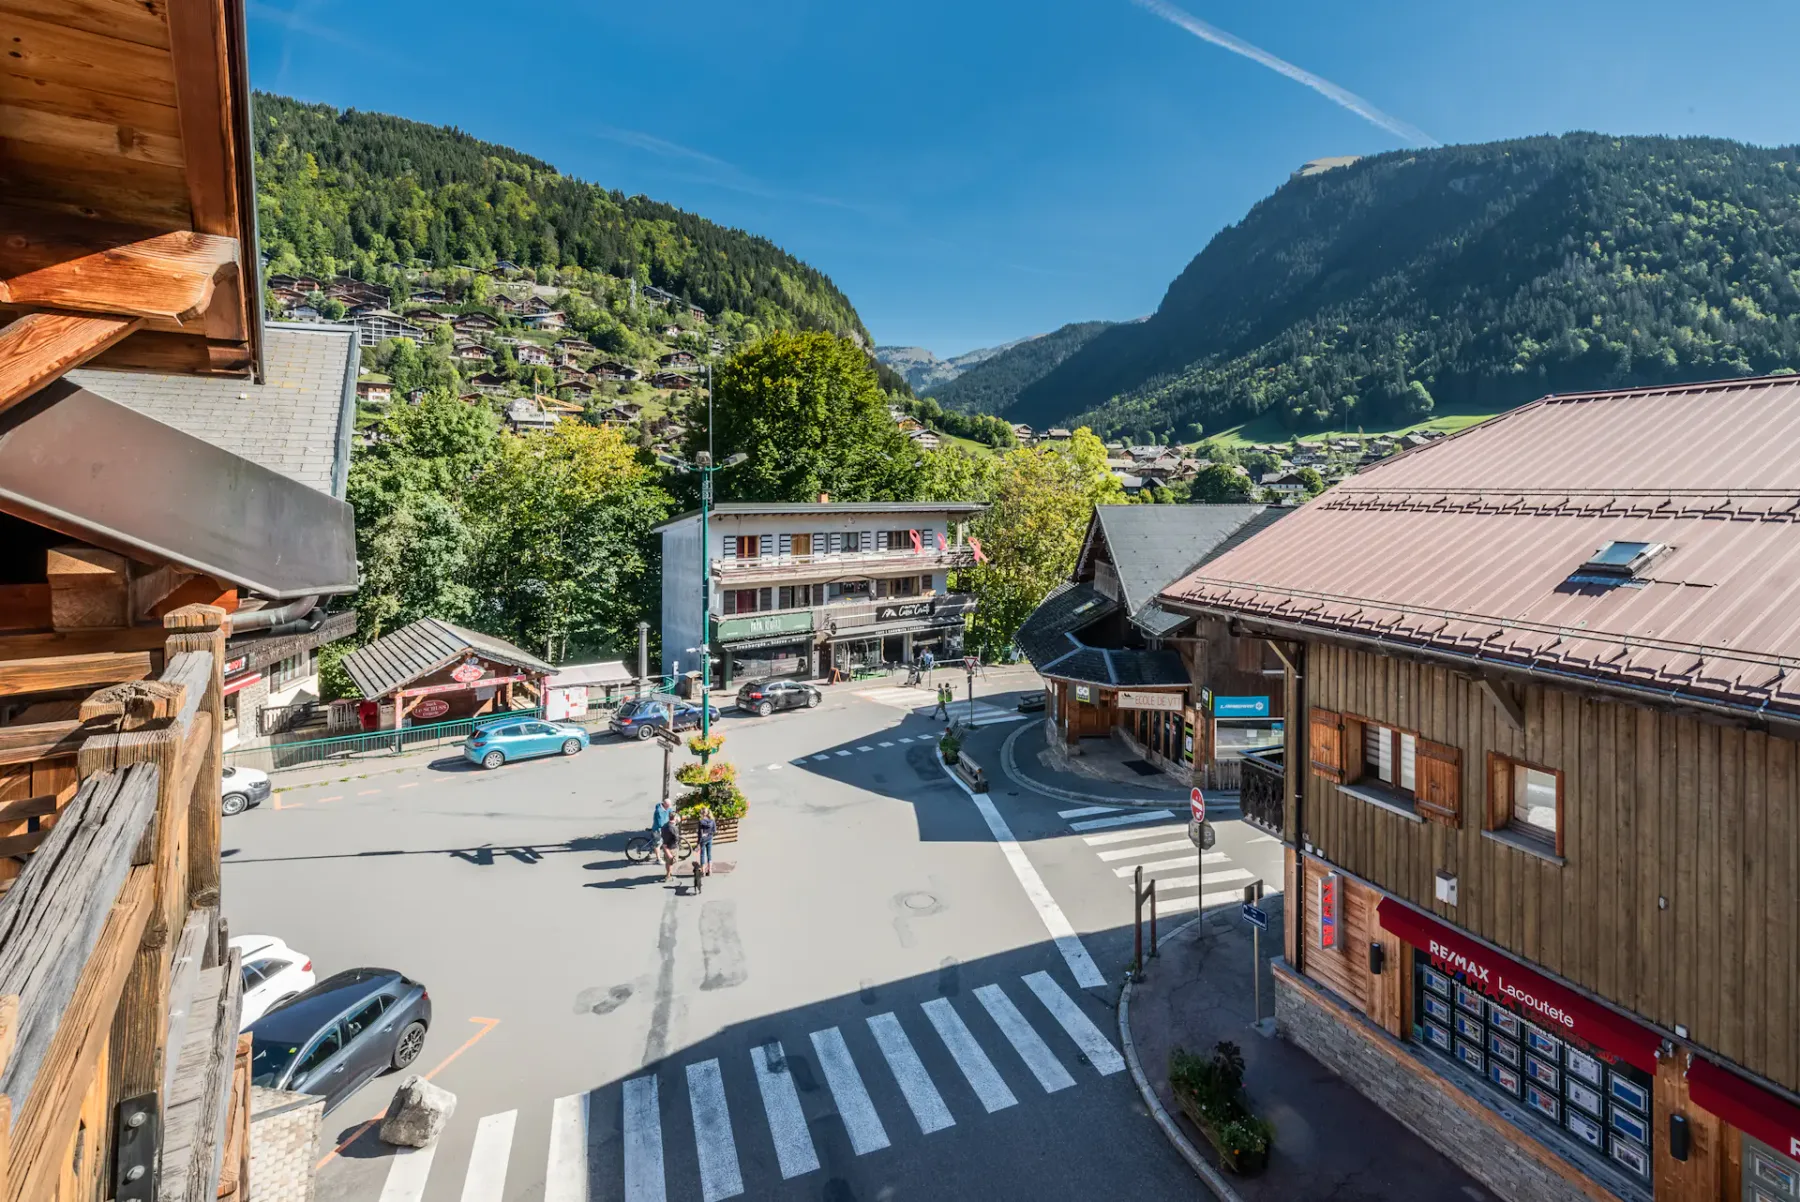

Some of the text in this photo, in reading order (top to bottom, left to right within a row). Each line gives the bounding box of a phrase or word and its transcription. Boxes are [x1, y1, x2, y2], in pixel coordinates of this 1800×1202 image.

[1077, 686, 1089, 696] GO
[1135, 695, 1154, 706] ECOLE
[1157, 696, 1166, 706] DE
[1323, 882, 1334, 947] RE/MAX
[1430, 940, 1574, 1027] RE/MAX Lacoutete
